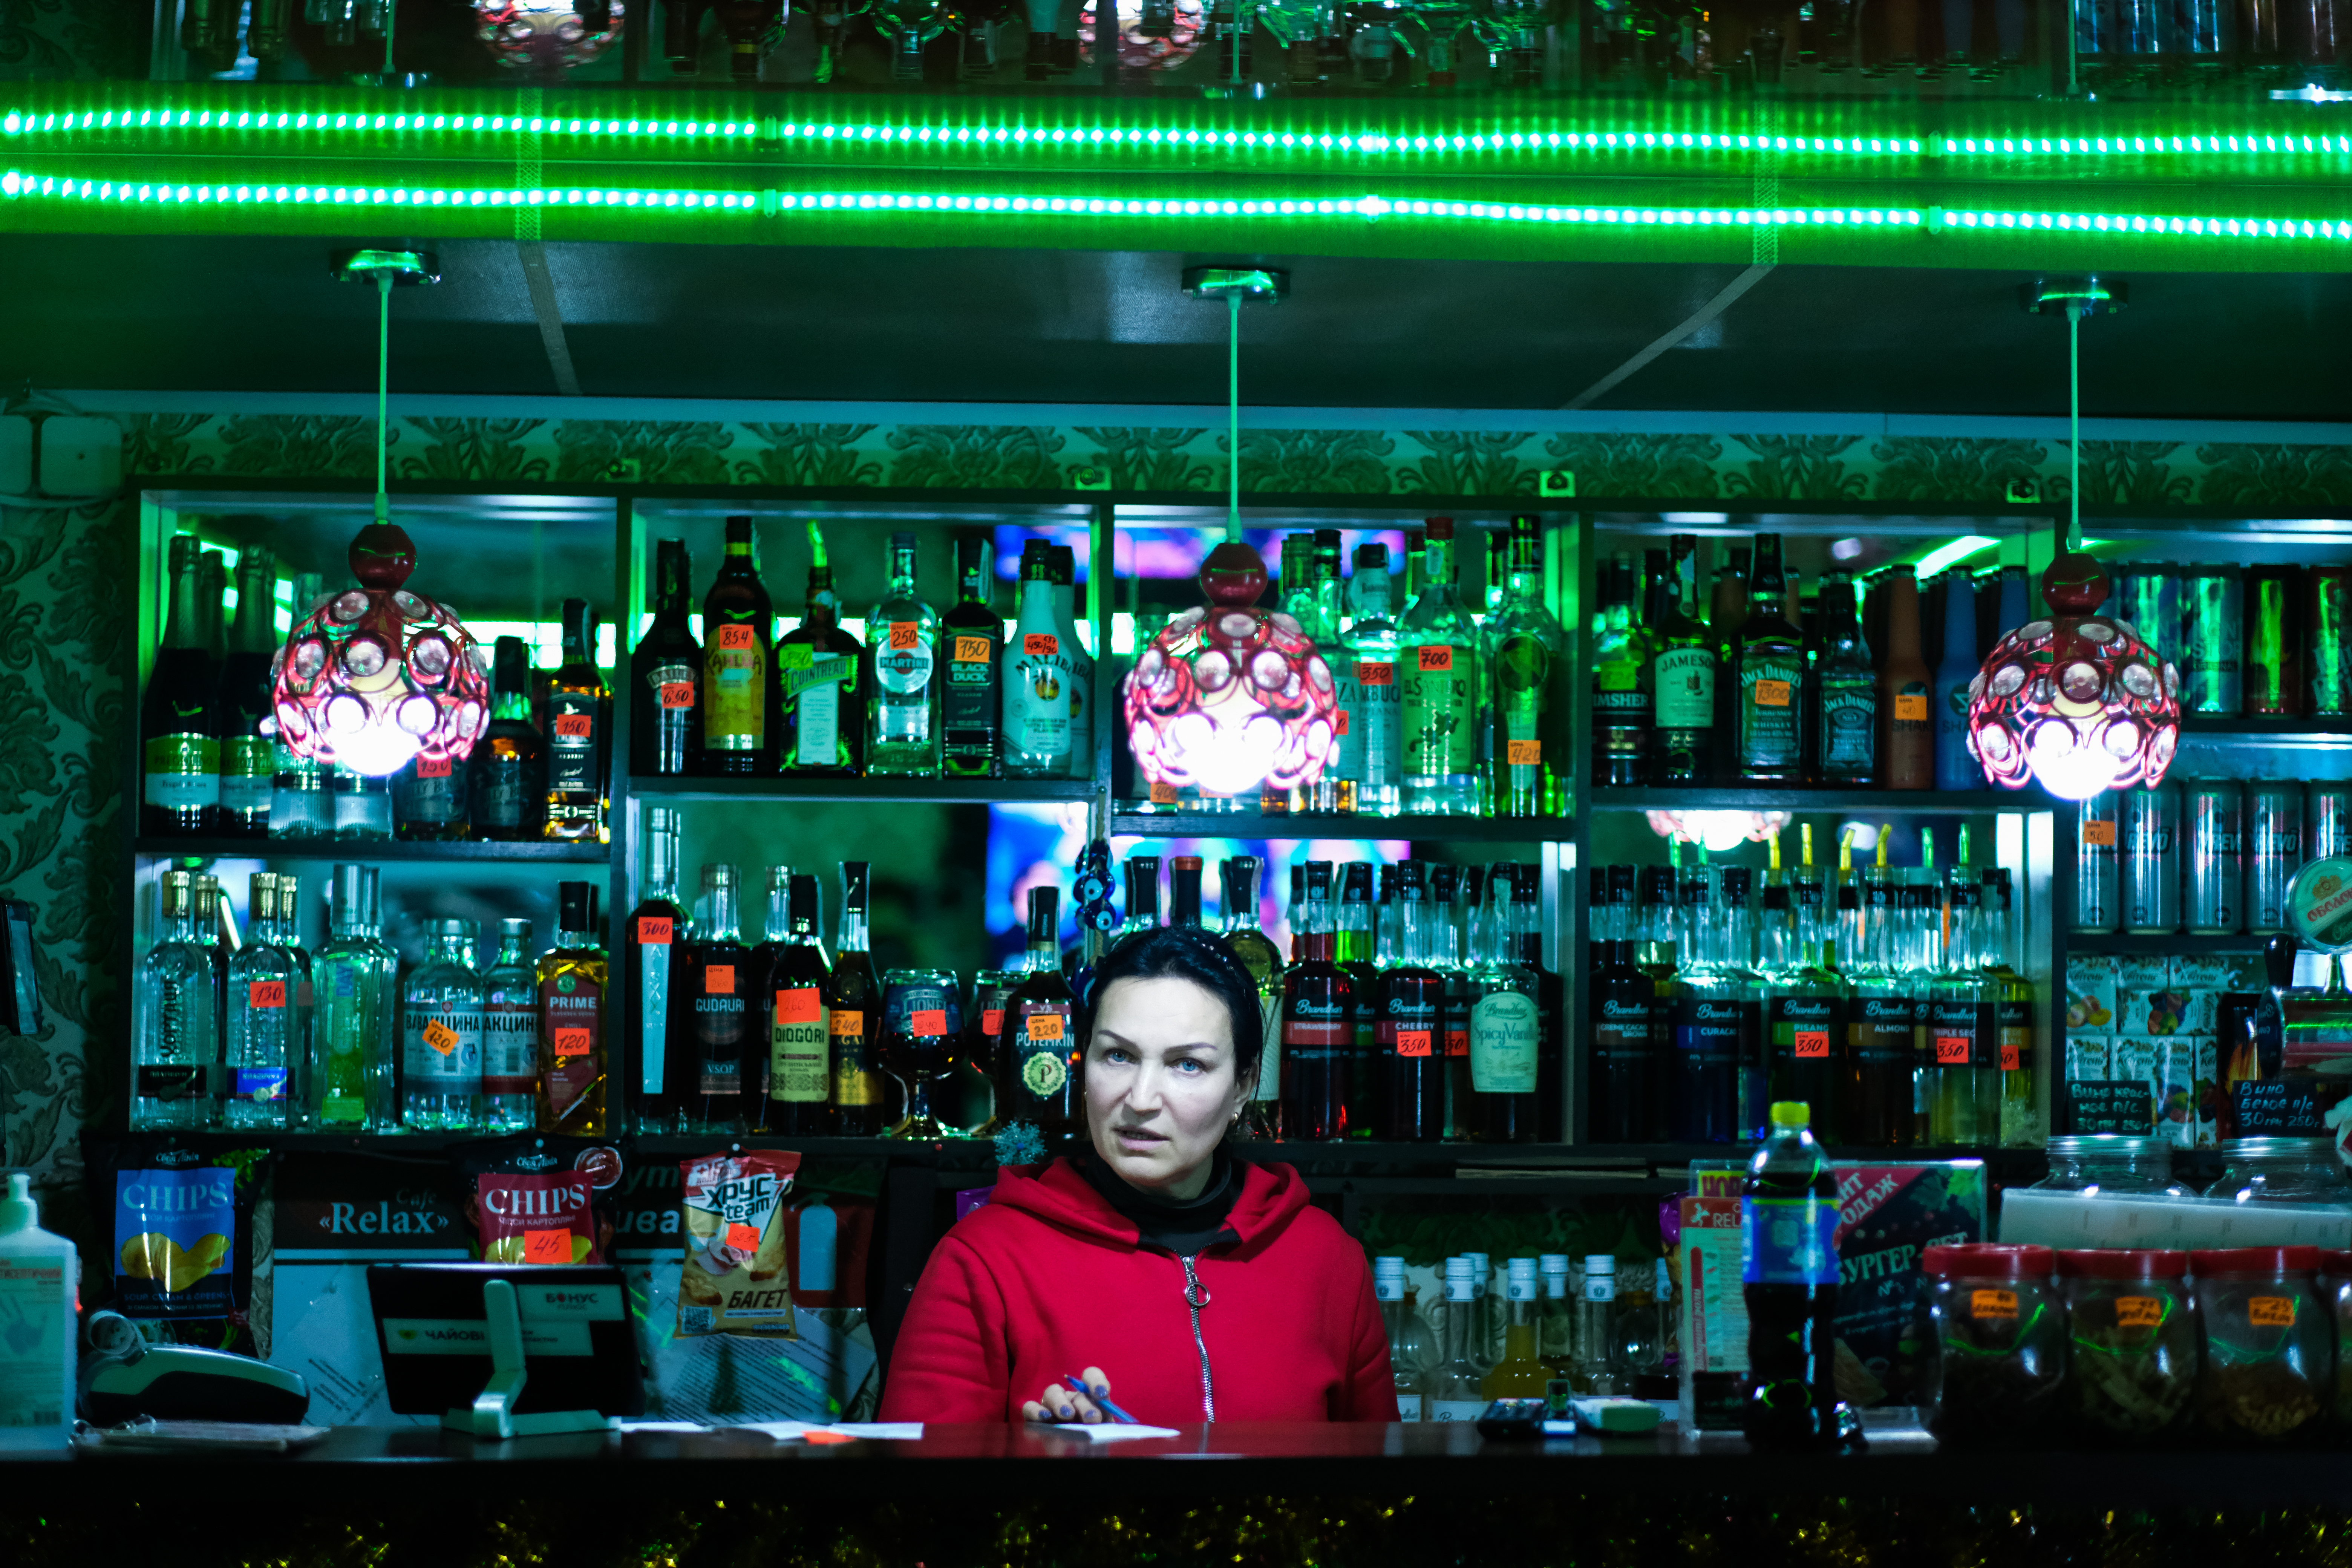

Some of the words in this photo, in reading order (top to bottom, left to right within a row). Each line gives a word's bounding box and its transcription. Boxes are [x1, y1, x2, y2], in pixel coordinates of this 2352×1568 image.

[722, 631, 749, 646] 854
[893, 629, 917, 648] 250
[880, 658, 928, 668] MARTINI
[1421, 652, 1449, 667] 700
[951, 663, 989, 672] BLACK
[1361, 667, 1390, 680] 350
[791, 660, 847, 691] COINTREAU
[953, 672, 986, 681] DUCK
[660, 689, 689, 704] 650
[562, 720, 586, 734] 150
[642, 922, 669, 936] 300
[257, 986, 282, 1003] 130
[550, 996, 597, 1009] PRIME
[695, 998, 745, 1013] GUDAURI
[1034, 1023, 1058, 1037] 220
[1395, 1022, 1434, 1031] CHERRY
[1874, 1024, 1910, 1033] ALMOND
[426, 1031, 451, 1049] 120
[558, 1034, 586, 1050] 120
[1400, 1039, 1426, 1053] 350
[1798, 1039, 1823, 1052] 350
[1938, 1044, 1964, 1058] 350
[707, 1063, 735, 1074] VSOP
[122, 1183, 228, 1211] CHIPS
[485, 1183, 586, 1216] CHIPS
[725, 1197, 770, 1220] team
[319, 1201, 449, 1234] «Relax»
[727, 1289, 787, 1309] БАГЕТ
